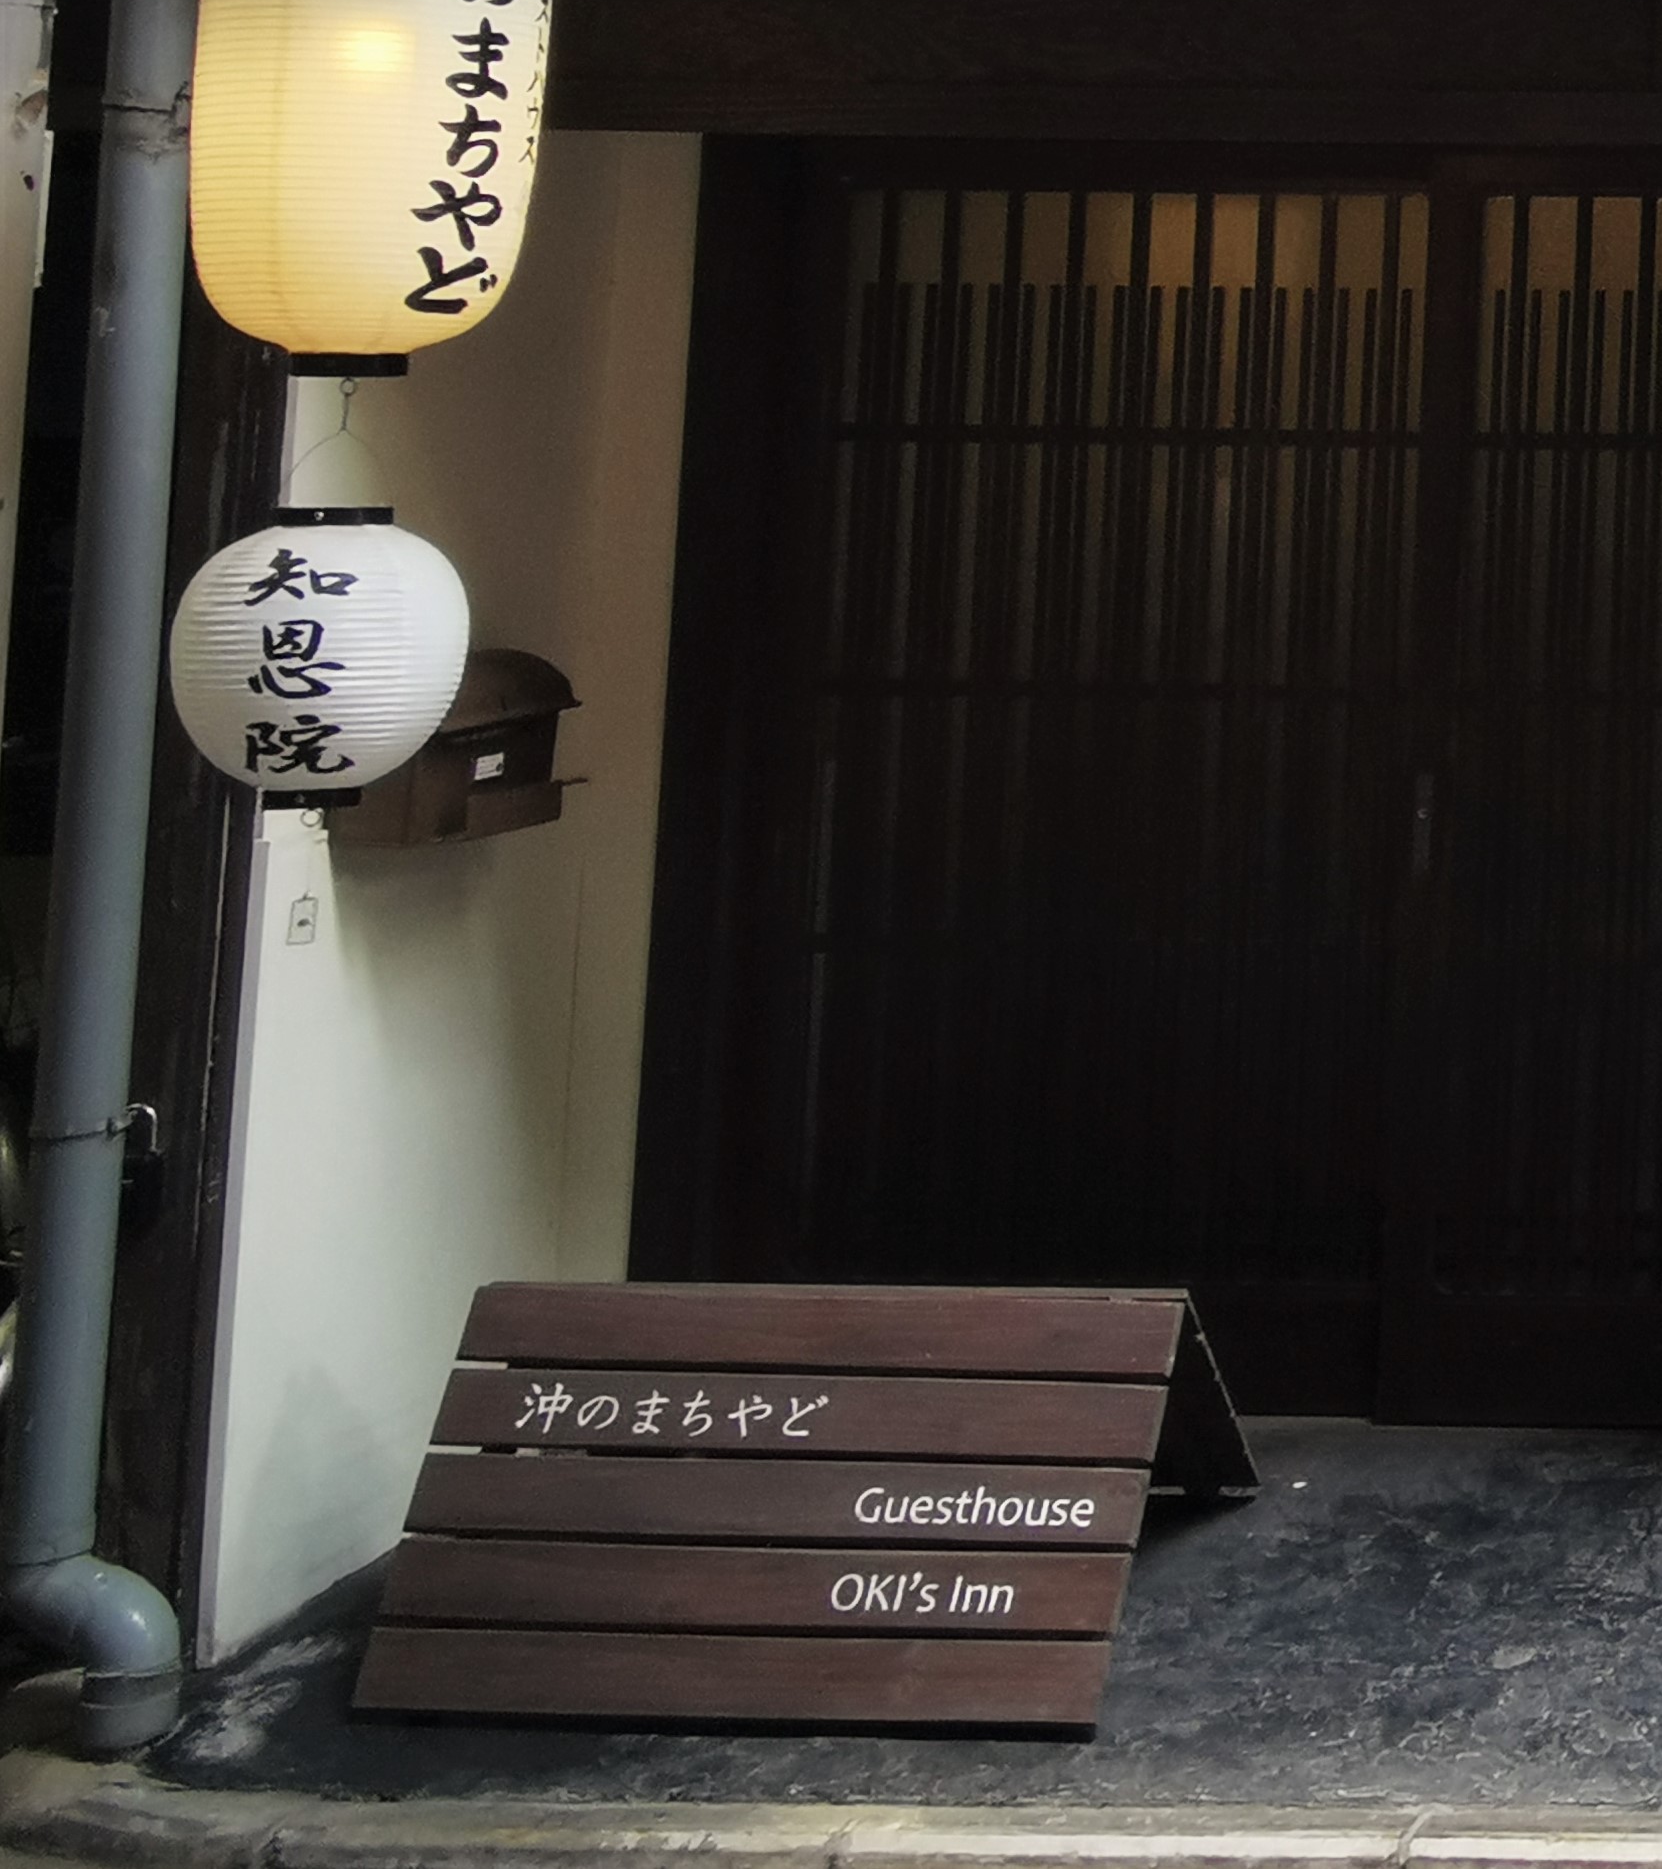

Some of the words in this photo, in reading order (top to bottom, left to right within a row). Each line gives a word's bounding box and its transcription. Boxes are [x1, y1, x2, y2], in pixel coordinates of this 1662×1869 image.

[244, 547, 360, 773] 知恩院
[514, 1382, 830, 1438] 沖のまちやど
[853, 1485, 1096, 1529] Guesthouse
[829, 1570, 939, 1614] OKI's
[948, 1574, 1015, 1615] Inn
